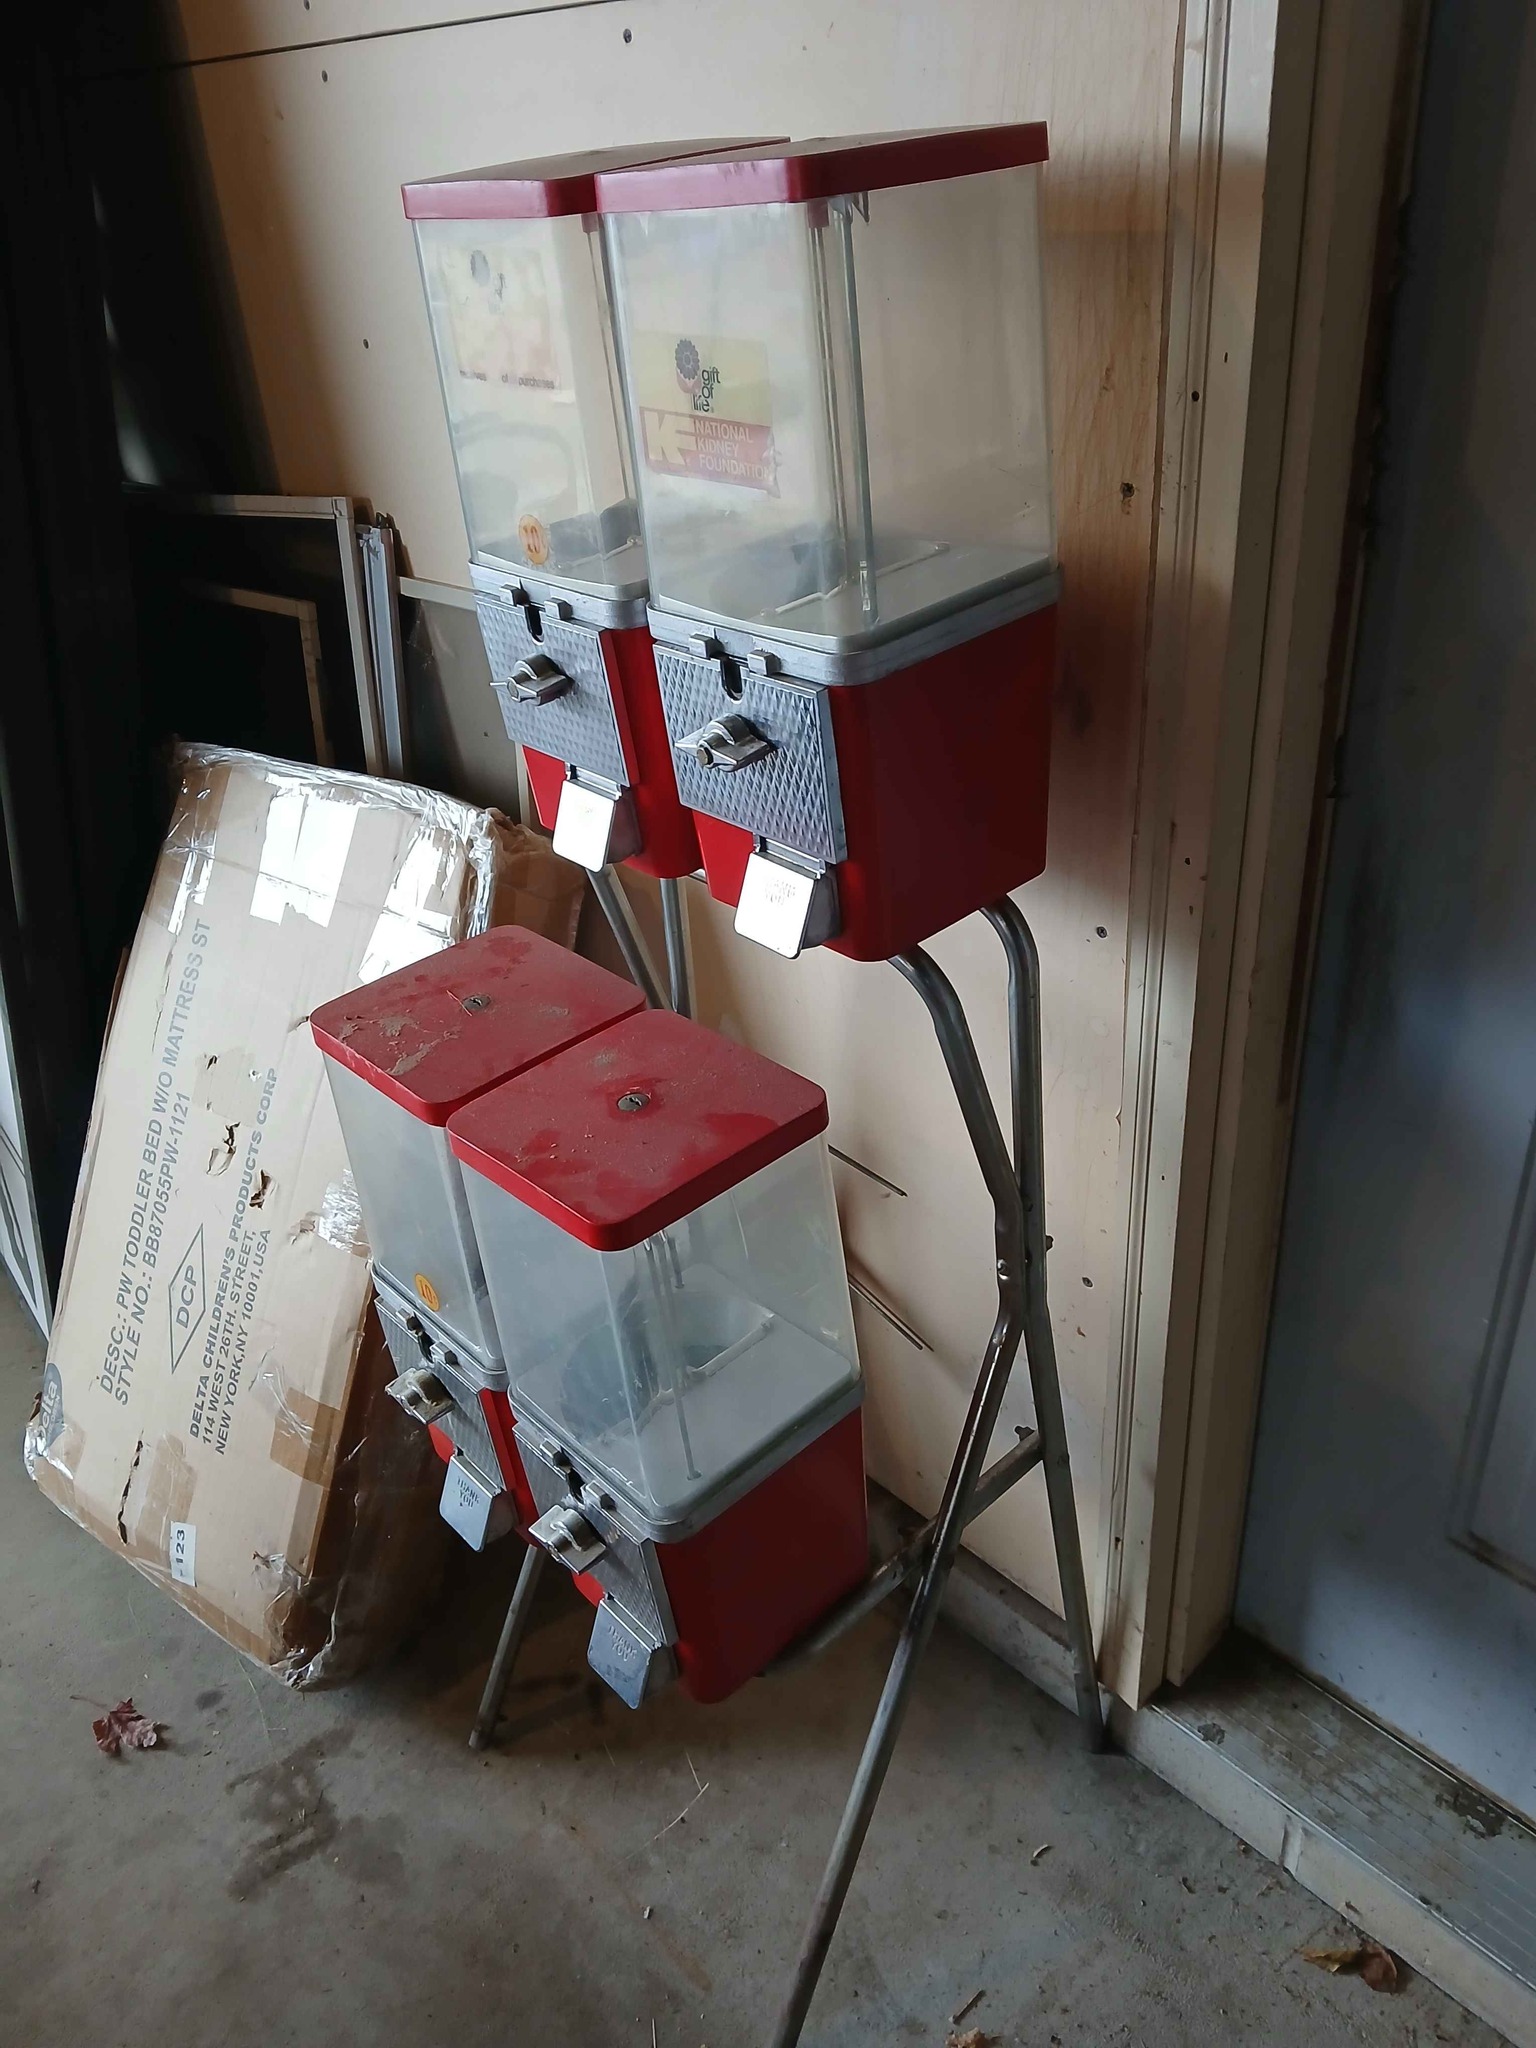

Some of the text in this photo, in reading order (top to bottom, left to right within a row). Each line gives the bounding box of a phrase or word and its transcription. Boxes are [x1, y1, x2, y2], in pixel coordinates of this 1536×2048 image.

[701, 366, 721, 386] gift
[701, 383, 714, 399] of
[694, 419, 753, 443] NATIONAL
[697, 436, 739, 458] KIDNEY
[700, 453, 773, 481] FOUNDATION
[100, 918, 211, 1395] DESC.: PW TODDLER BED W/O MATTRESS ST
[115, 1325, 141, 1406] STYLE
[142, 1092, 191, 1268] BB87055PW-1121
[189, 1067, 277, 1438] DELTA CHILDREN'S PRODUCTS CORP
[175, 1264, 198, 1329] DCP
[202, 1230, 256, 1445] 114 WEST 26TH. STREET,
[215, 1410, 235, 1455] NEW
[457, 1477, 480, 1504] THANK
[459, 1490, 474, 1508] YOU
[612, 1642, 628, 1662] YOU
